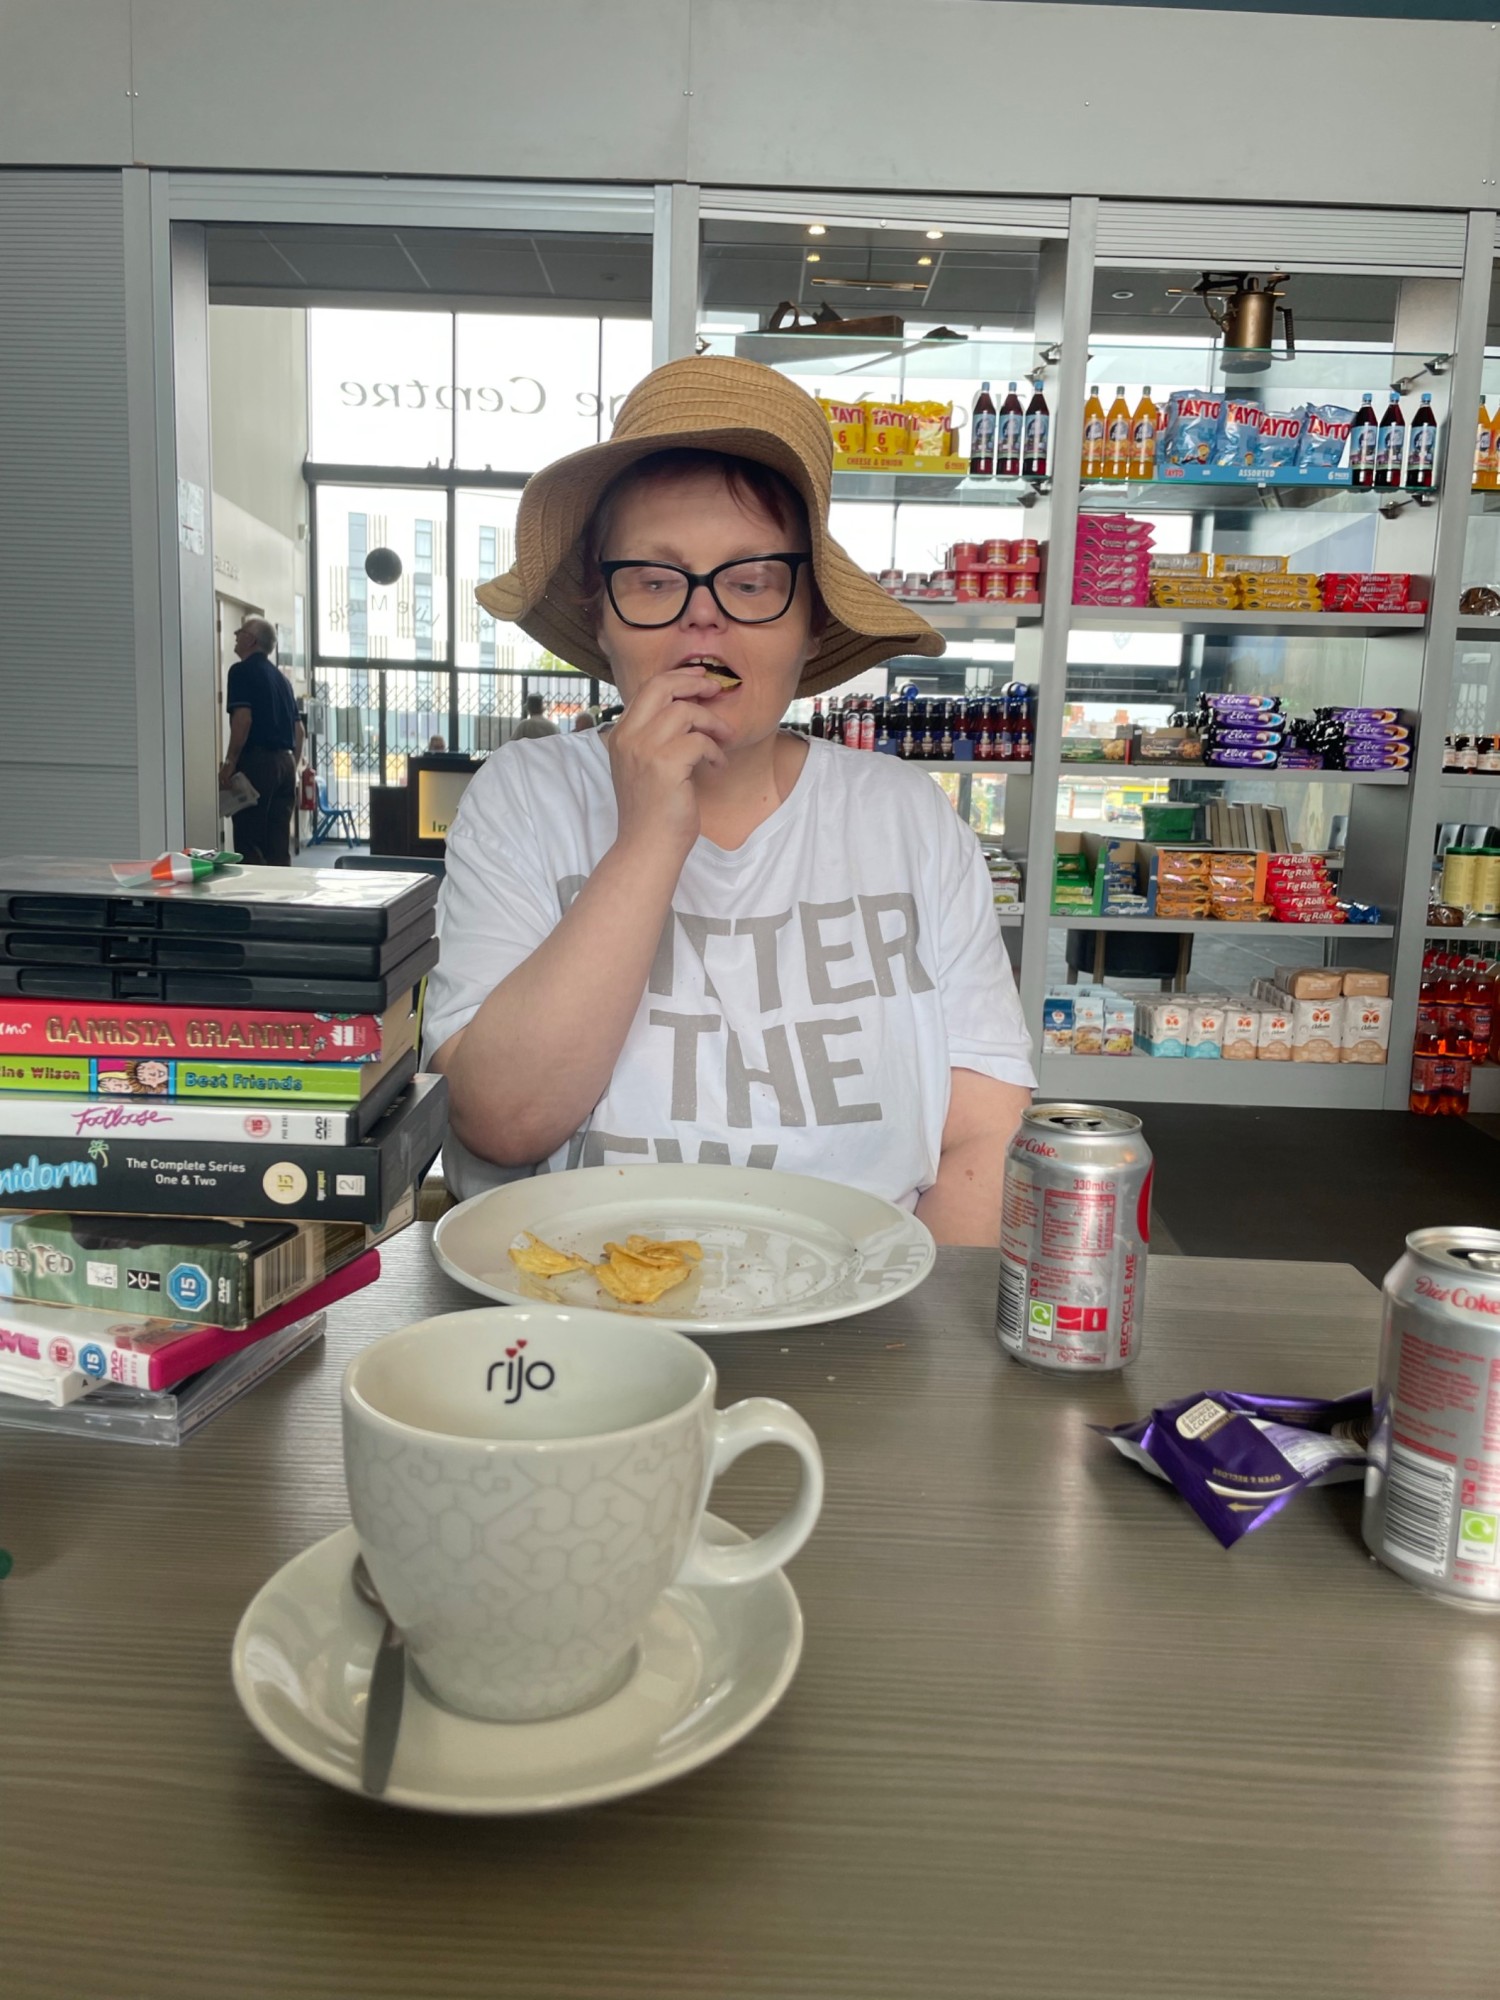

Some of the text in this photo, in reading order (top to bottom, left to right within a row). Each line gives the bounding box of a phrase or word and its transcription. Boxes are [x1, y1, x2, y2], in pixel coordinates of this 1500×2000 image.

[831, 407, 864, 424] TAYT
[1177, 398, 1219, 420] TAYTO
[1260, 417, 1300, 438] AYTO
[1307, 414, 1349, 441] TAYTO
[838, 430, 847, 443] 6
[878, 432, 886, 445] 6
[1238, 468, 1275, 478] ASSORTED
[1327, 471, 1333, 480] 6
[1278, 856, 1311, 866] Fig Rolls
[1282, 868, 1315, 878] Fig Rolls
[1286, 881, 1320, 892] Fig Rolls
[1291, 897, 1325, 907] Fig Rolls
[1298, 912, 1332, 922] Fig Rolls
[46, 1016, 314, 1049] GANGSTA GRANNY
[0, 1066, 81, 1080] ine Wilson
[648, 1008, 883, 1128] THE
[185, 1071, 304, 1091] Best Friends
[71, 1105, 174, 1135] Footloose
[252, 1118, 264, 1132] 15
[1025, 1138, 1056, 1158] Coke
[126, 1157, 246, 1173] The Complete Series
[0, 1154, 98, 1195] nidorm
[155, 1173, 217, 1186] One & Two
[181, 1277, 197, 1298] 15
[1120, 1253, 1135, 1357] RECYCLE ME
[1451, 1287, 1500, 1316] Coke
[56, 1345, 68, 1362] 15
[87, 1352, 100, 1370] 15
[487, 1346, 555, 1404] rijo
[1192, 1408, 1220, 1430] COCOA
[1258, 1473, 1281, 1484] OPEN
